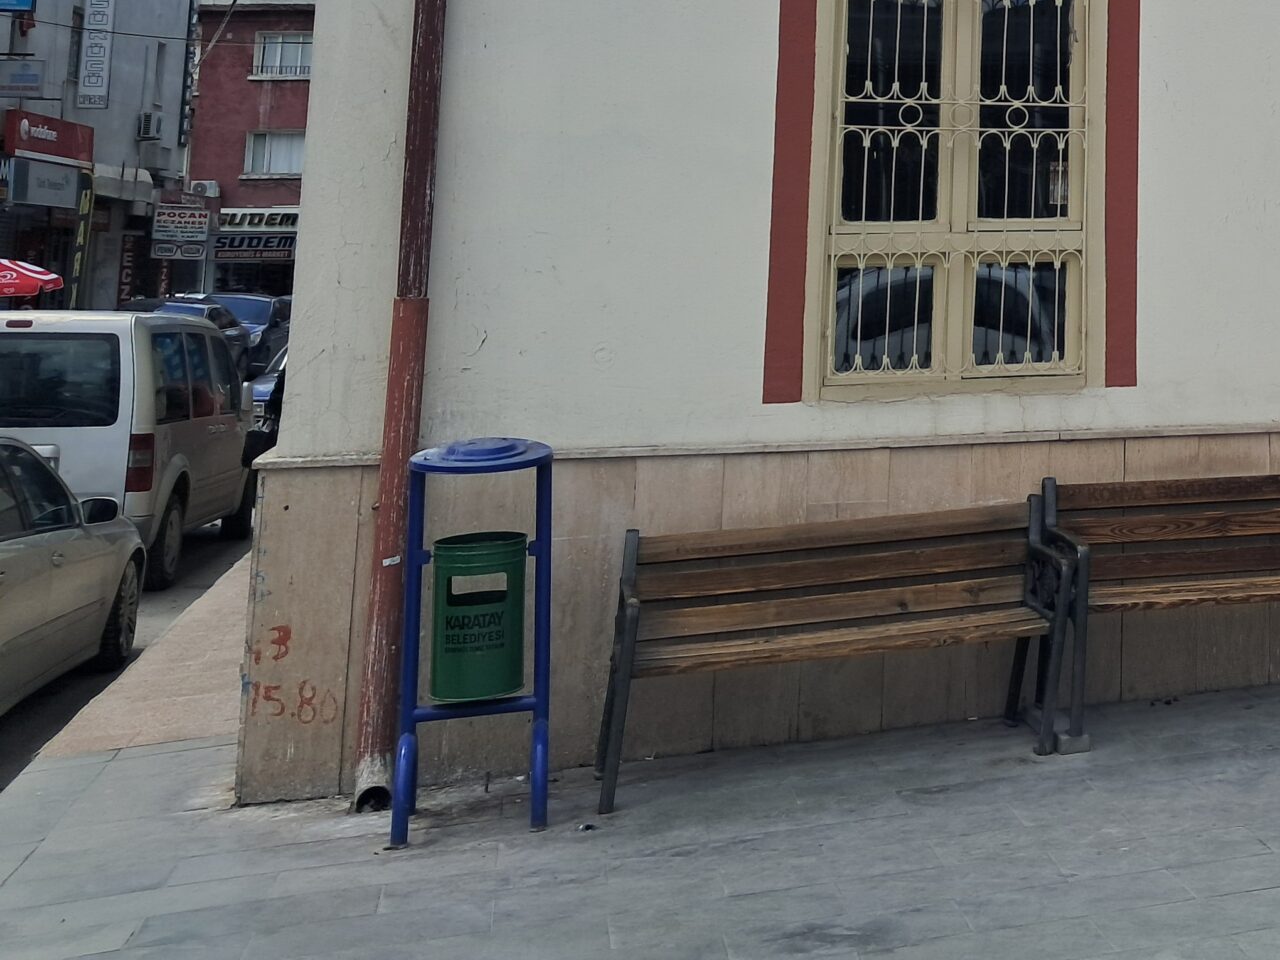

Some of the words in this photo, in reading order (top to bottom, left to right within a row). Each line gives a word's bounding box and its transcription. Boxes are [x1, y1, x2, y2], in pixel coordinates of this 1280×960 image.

[29, 124, 57, 142] vodafone
[218, 212, 299, 226] SUDEM
[213, 236, 297, 248] SUDEM
[445, 610, 505, 630] KARATAY
